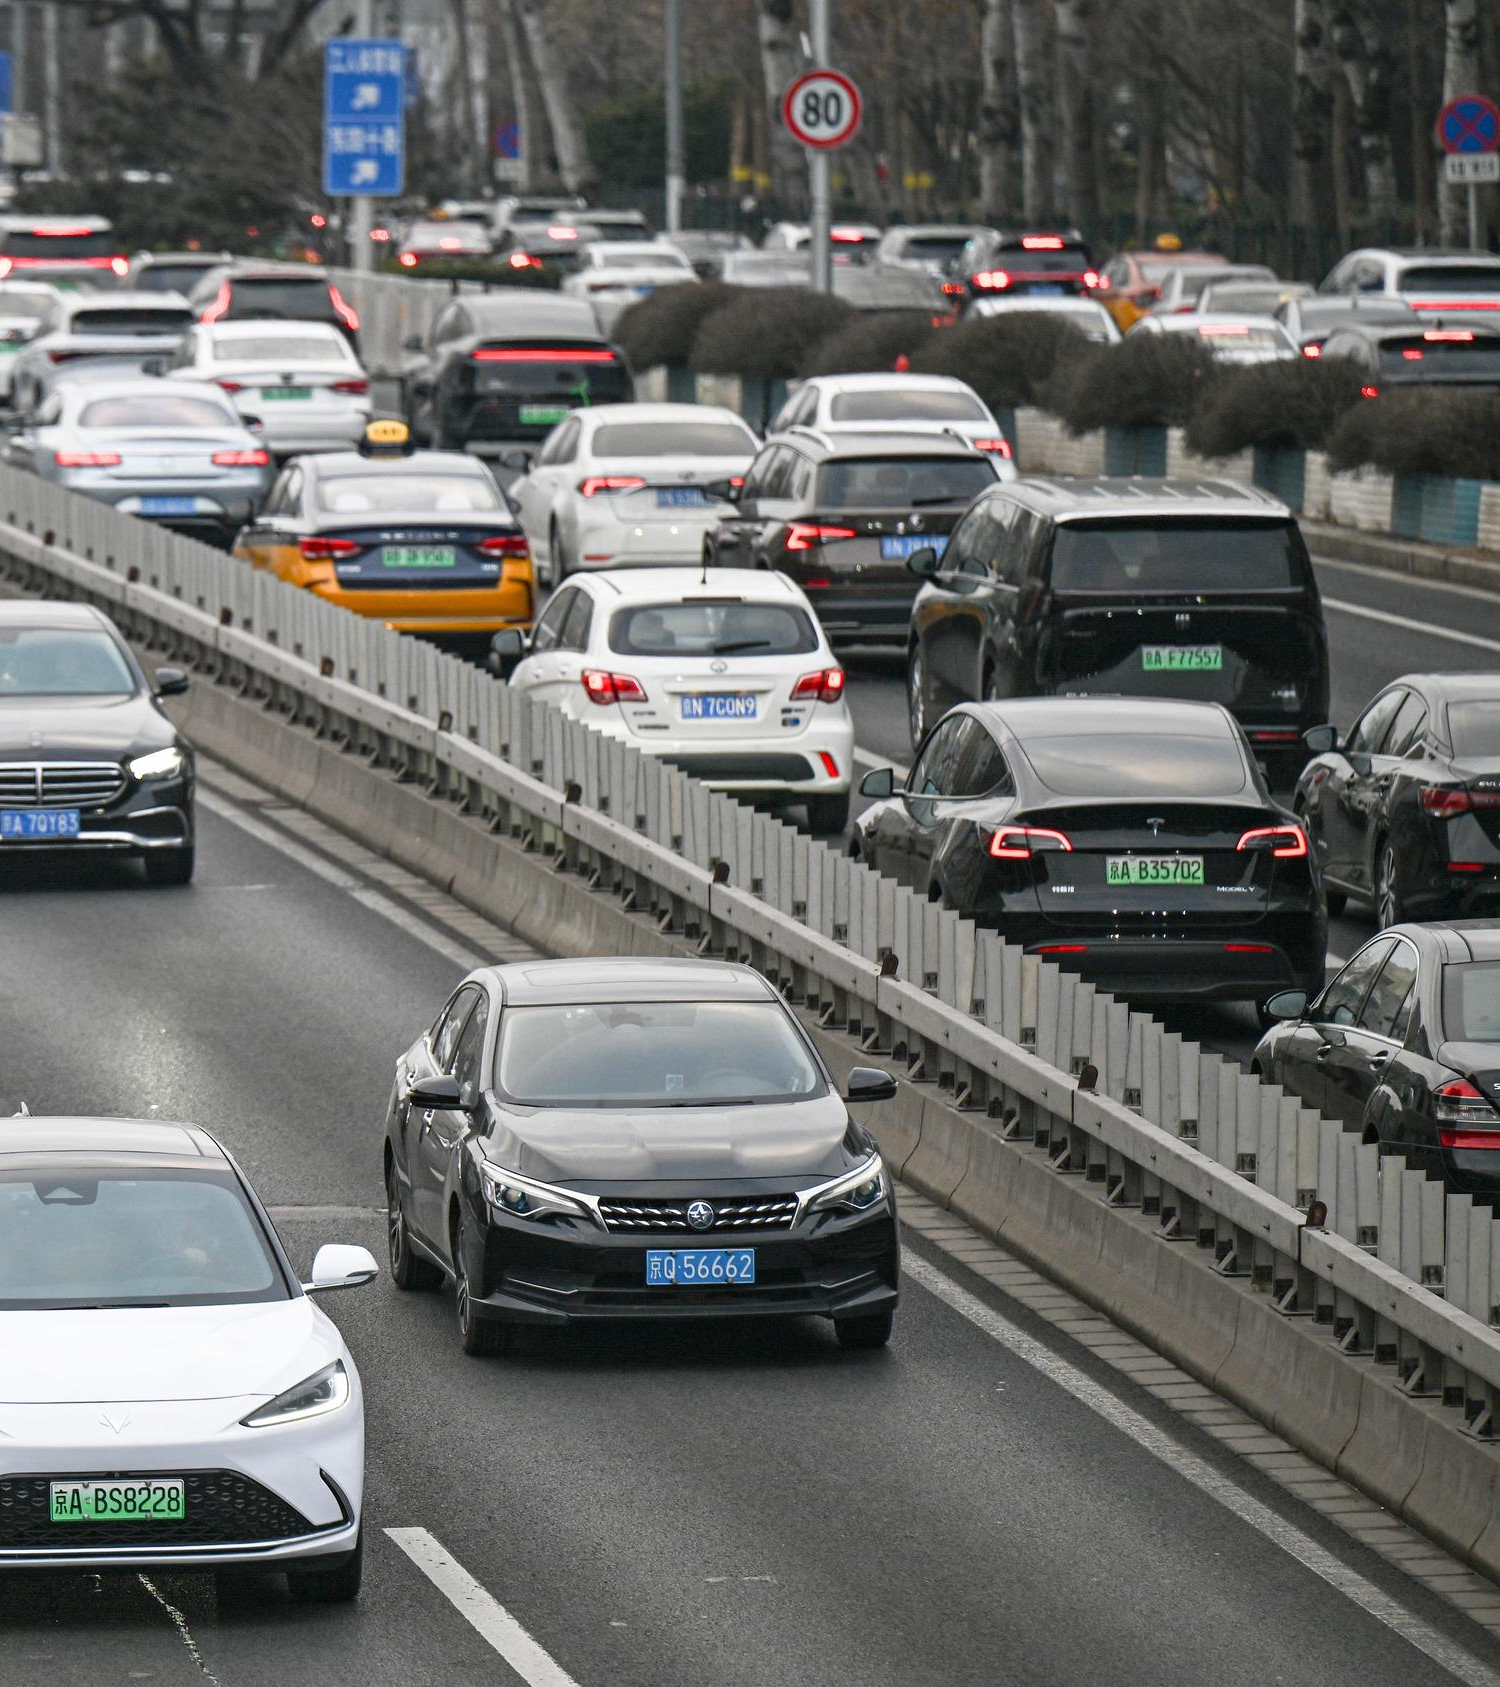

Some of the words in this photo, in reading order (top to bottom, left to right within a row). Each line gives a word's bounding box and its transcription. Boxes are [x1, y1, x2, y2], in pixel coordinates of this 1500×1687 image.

[804, 92, 840, 128] 80
[28, 813, 78, 833] 7QY83
[1139, 861, 1201, 880] B35702
[95, 1487, 180, 1514] BS8228
